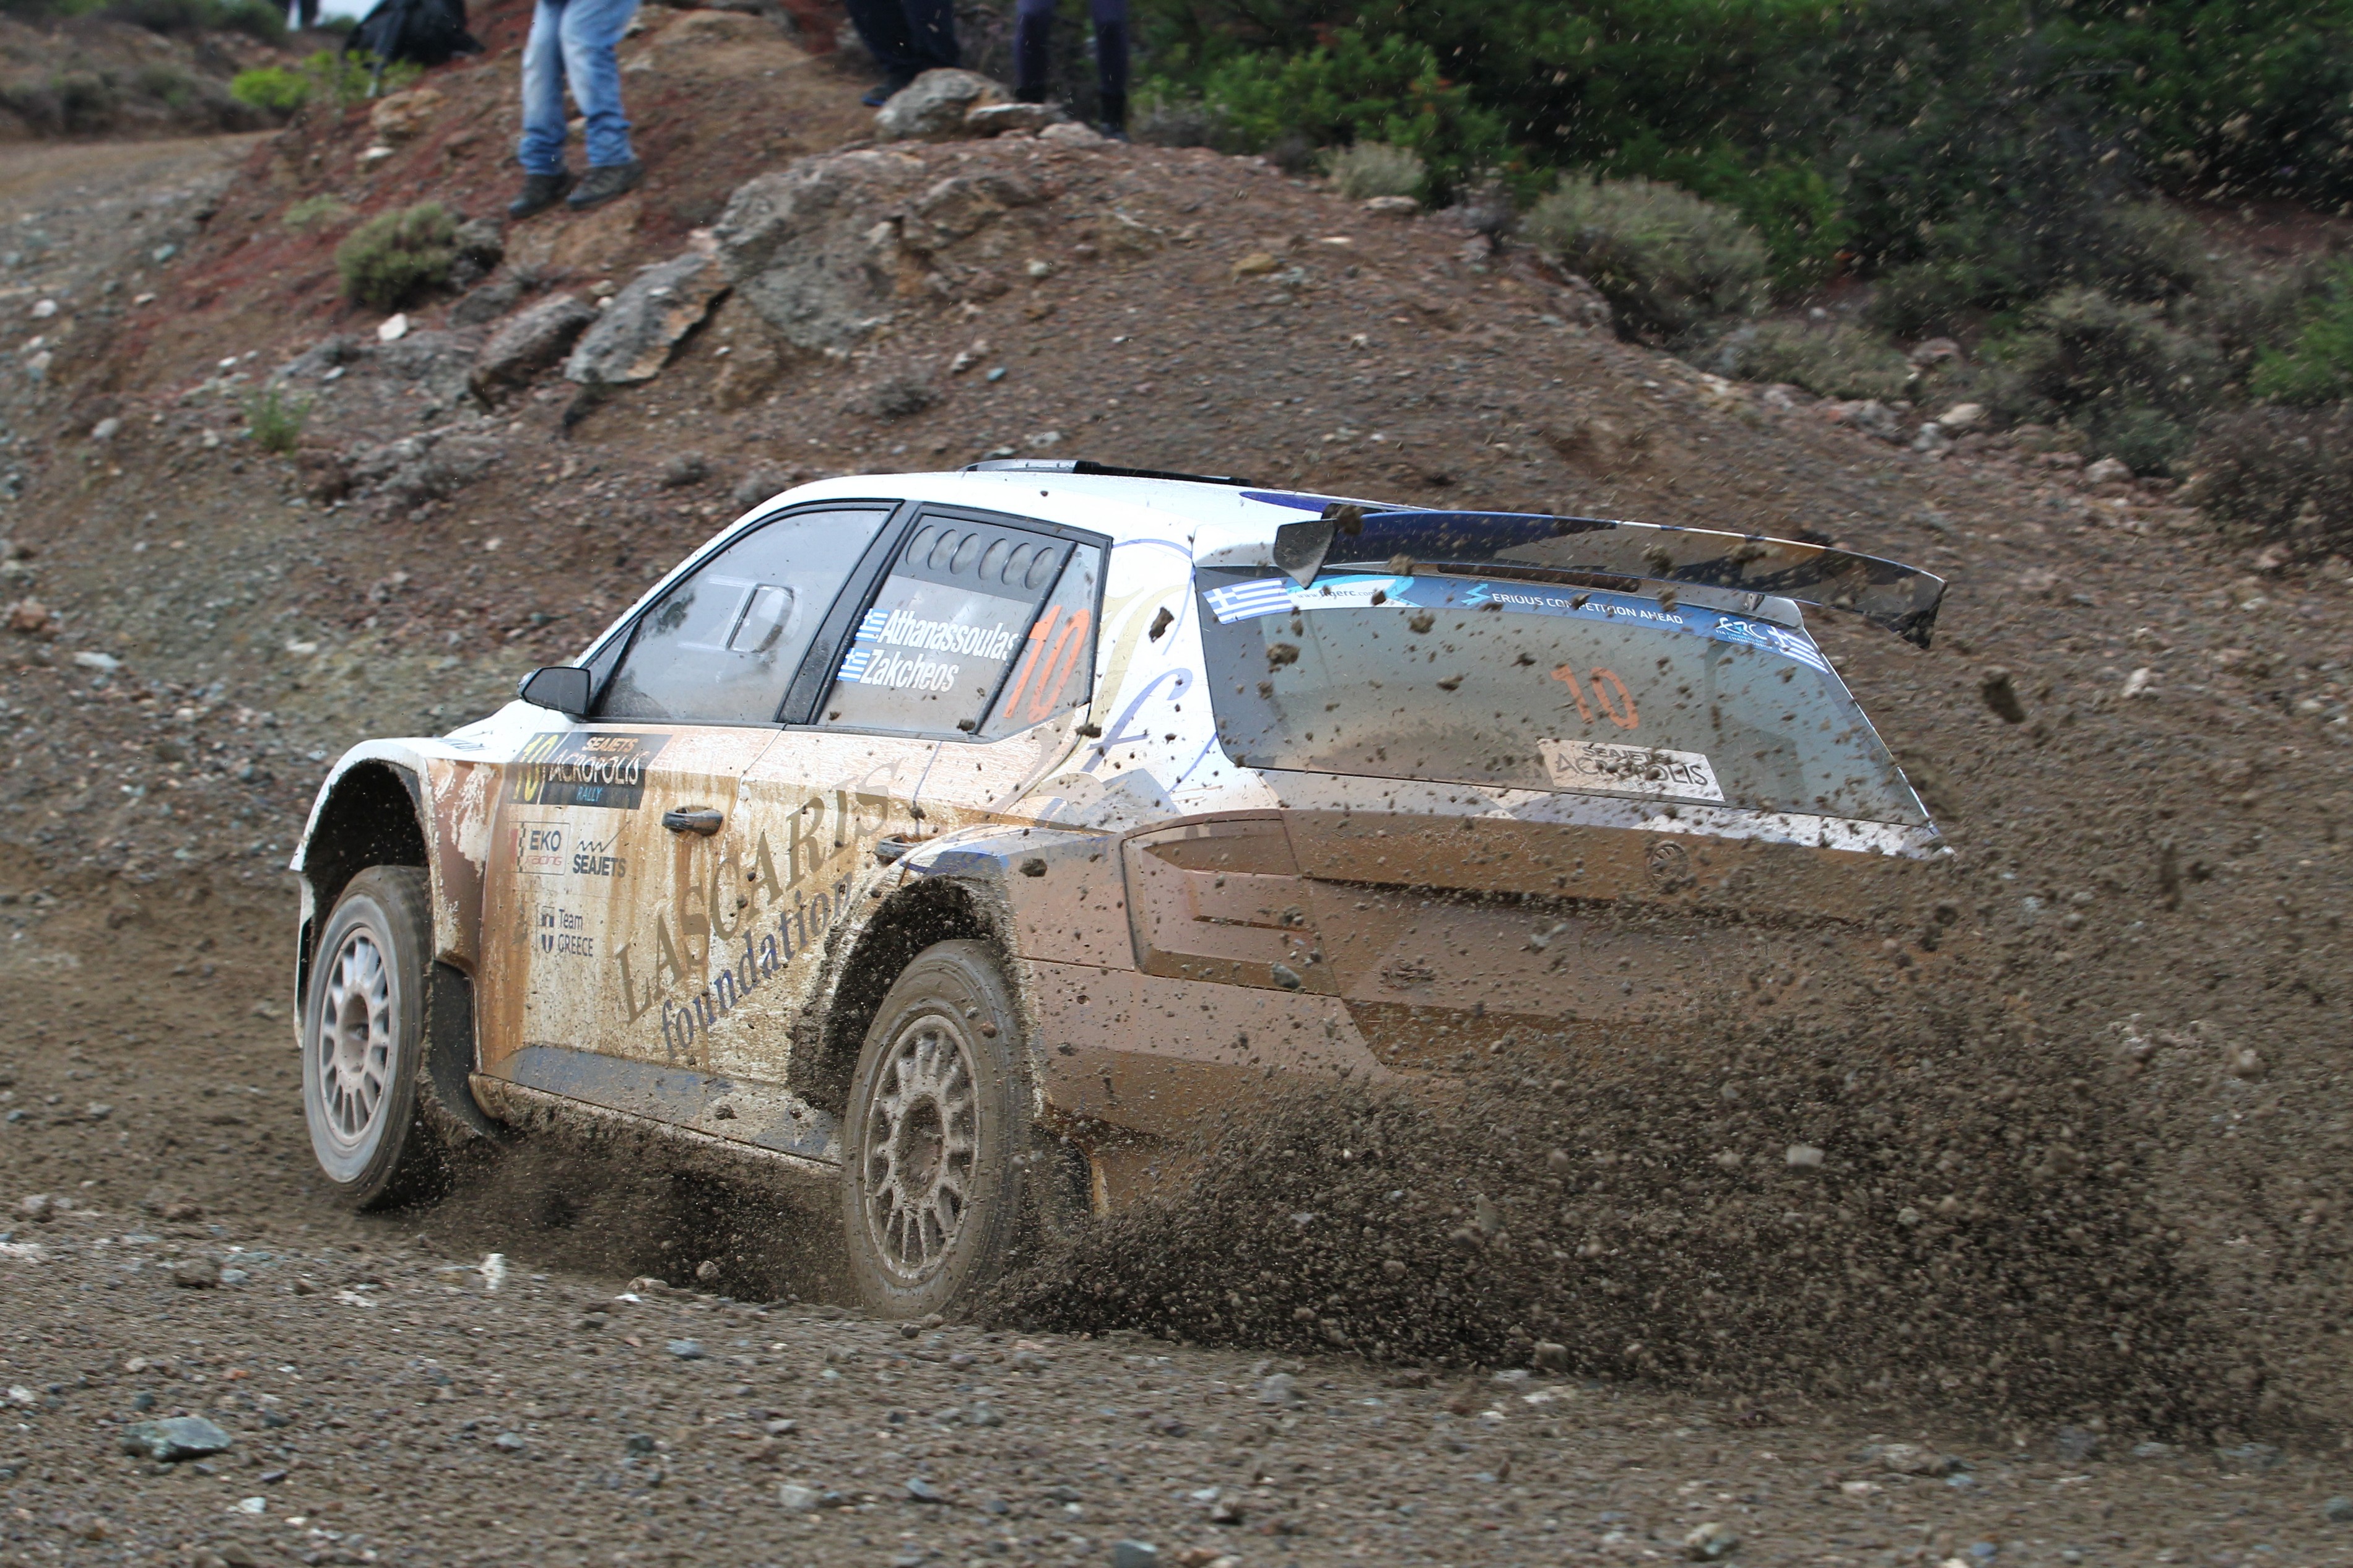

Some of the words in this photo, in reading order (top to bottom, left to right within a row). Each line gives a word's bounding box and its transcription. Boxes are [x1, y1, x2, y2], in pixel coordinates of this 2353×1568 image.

[876, 609, 1020, 661] Athanassoulas
[1640, 609, 1684, 625] AHEAD
[859, 648, 960, 692] Zakcheos
[1003, 605, 1090, 724] 10
[1551, 664, 1640, 730] 10
[581, 736, 639, 753] SEAJETS
[513, 734, 559, 802] 10
[548, 749, 650, 786] ACROPOLIS
[576, 786, 603, 802] RALLY
[530, 830, 562, 852] EKO
[573, 853, 627, 878] SEAJETS
[614, 757, 906, 1027] LASCARIS
[559, 908, 583, 930] Team
[558, 933, 593, 957] GREECE
[659, 872, 853, 1060] foundation
